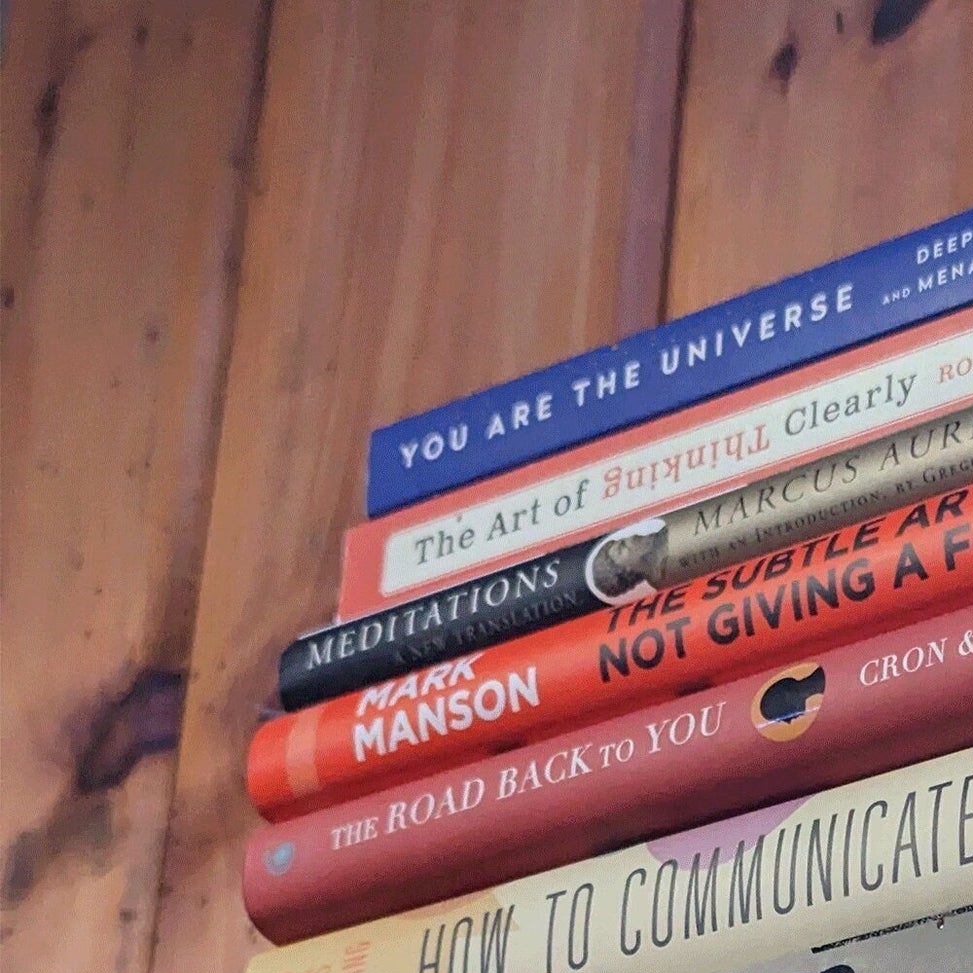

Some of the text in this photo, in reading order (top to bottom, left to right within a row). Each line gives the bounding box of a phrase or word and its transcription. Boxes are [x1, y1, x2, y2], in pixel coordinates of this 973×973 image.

[881, 285, 912, 306] AND
[399, 285, 855, 469] YOU ARE THE UNIVERSE
[415, 369, 917, 567] The Art of Thinking Clearly
[691, 454, 863, 538] MARCUS
[304, 558, 562, 671] MEDITATIONS
[455, 589, 579, 648] TRANSLATION
[598, 614, 700, 685] NOT
[705, 555, 877, 646] GIVING
[893, 542, 930, 592] A
[604, 587, 688, 634] THE
[702, 520, 883, 602] SUBTLE
[352, 665, 542, 763] MANSON
[355, 651, 490, 718] MARK
[858, 637, 948, 688] CRON
[330, 701, 728, 852] THE ROAD BACK TO YOU
